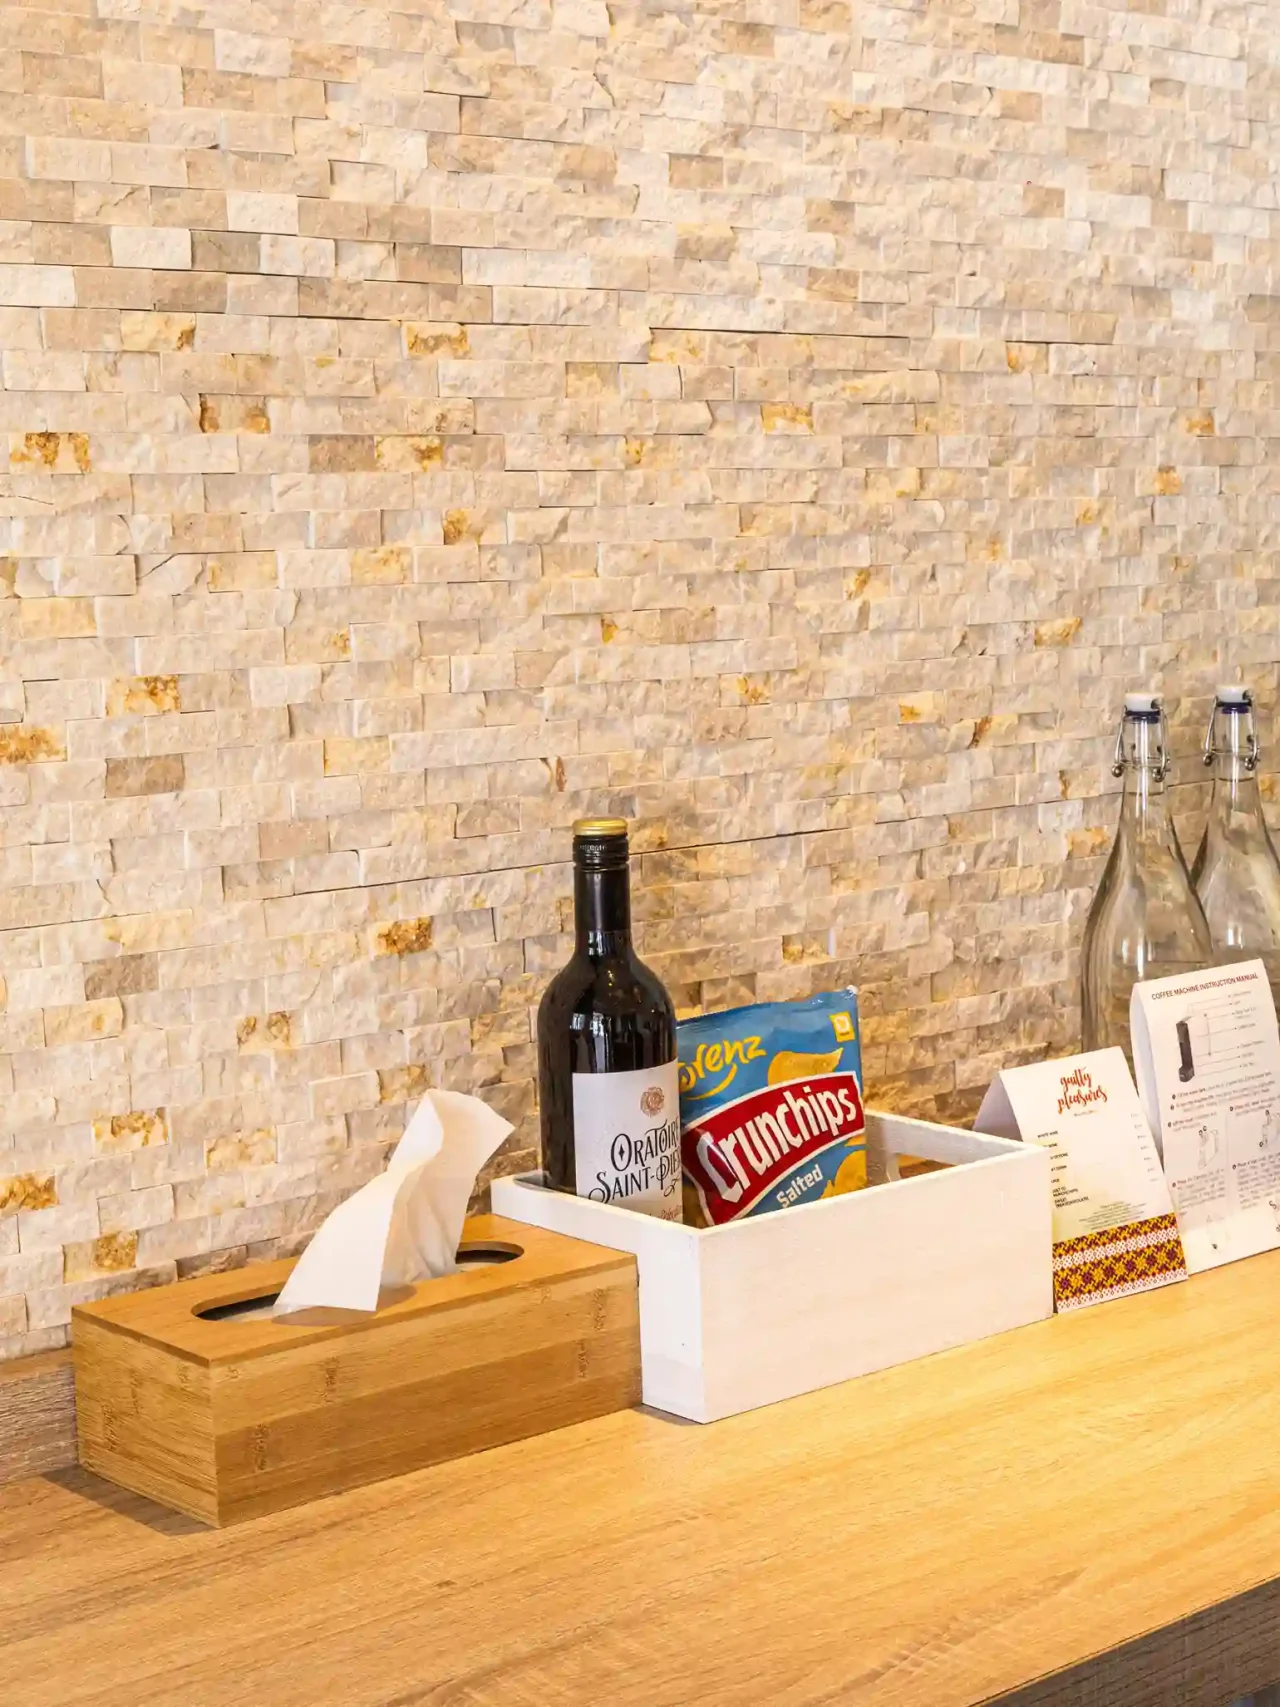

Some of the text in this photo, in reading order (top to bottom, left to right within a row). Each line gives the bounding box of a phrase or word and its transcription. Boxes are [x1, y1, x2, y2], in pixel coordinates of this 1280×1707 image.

[1151, 972, 1259, 1000] COFFEE MACHINE INSTRUCTION MANUAL
[678, 1036, 767, 1092] orenz
[1057, 1085, 1108, 1114] pleasures
[696, 1086, 857, 1203] Crunchips
[776, 1164, 824, 1208] Salted
